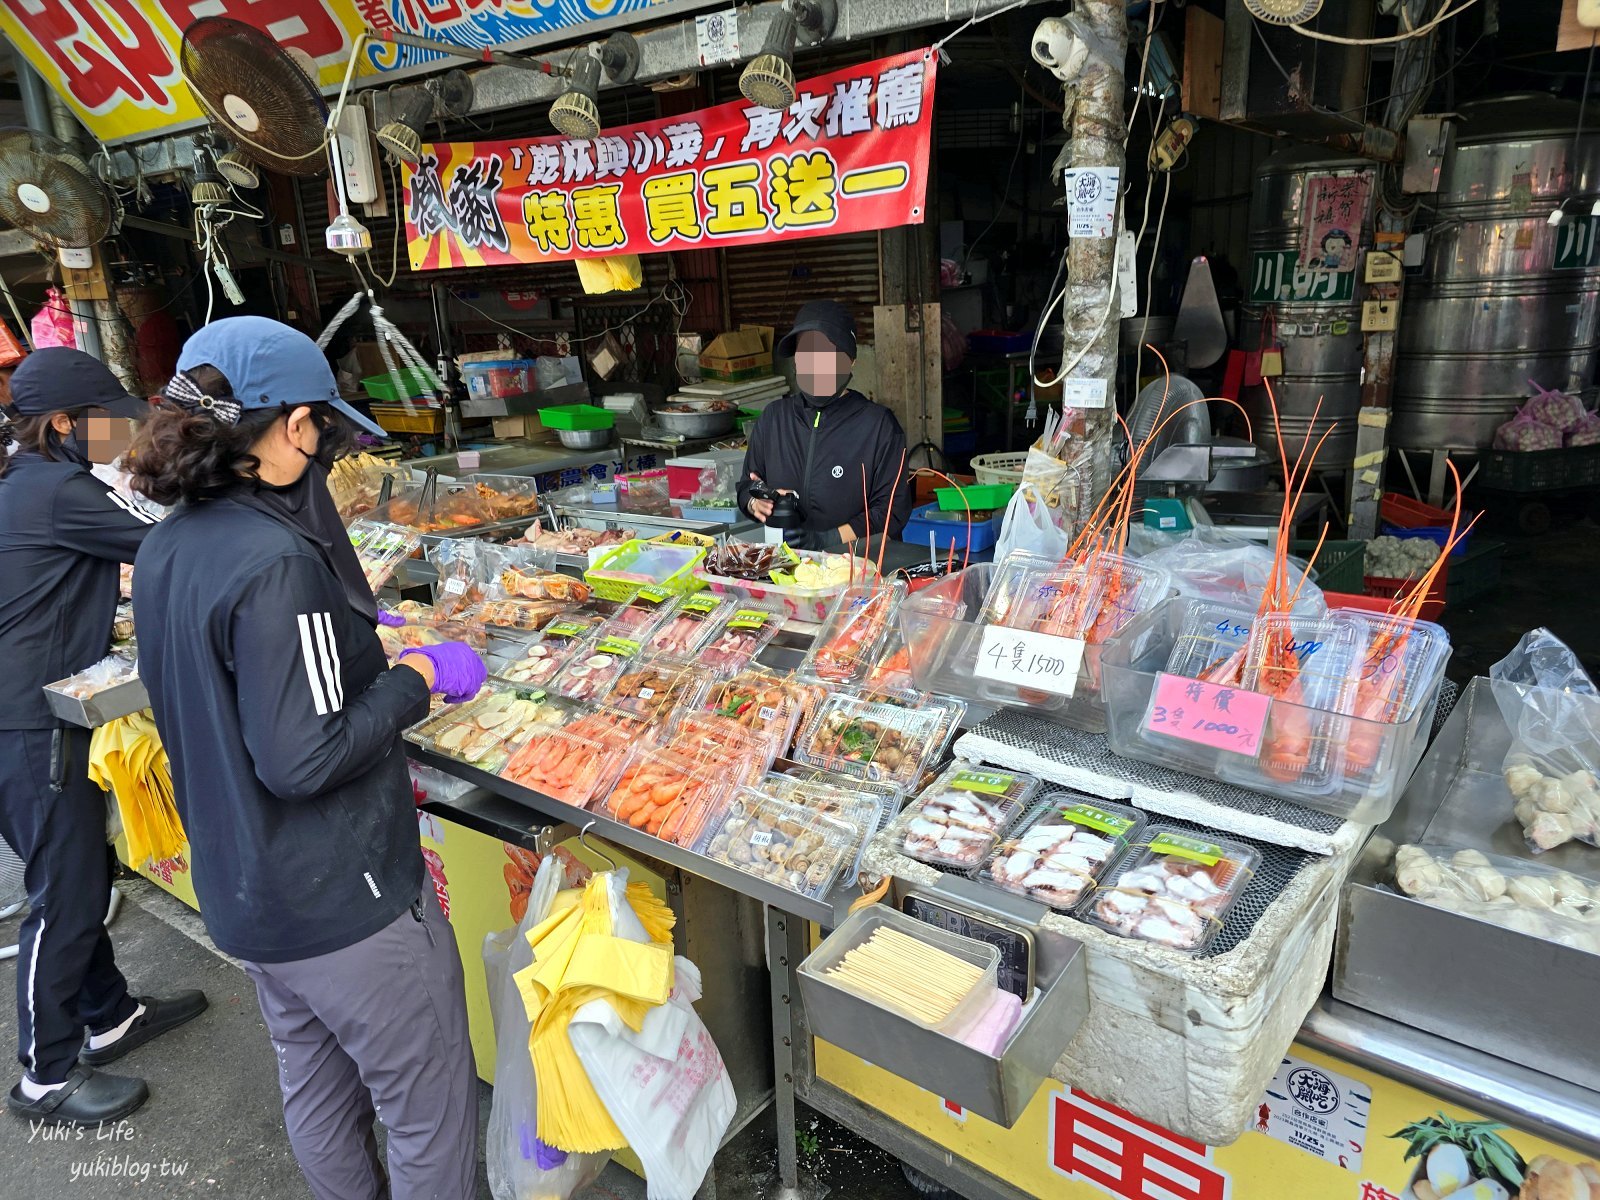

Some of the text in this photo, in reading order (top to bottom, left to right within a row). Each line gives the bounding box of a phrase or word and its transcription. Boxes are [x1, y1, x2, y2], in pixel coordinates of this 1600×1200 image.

[739, 60, 925, 153] 再次推薦
[410, 154, 509, 251] 感謝
[522, 150, 908, 253] 特惠 買五送一
[1215, 619, 1250, 637] 450
[1185, 682, 1236, 713] 特價
